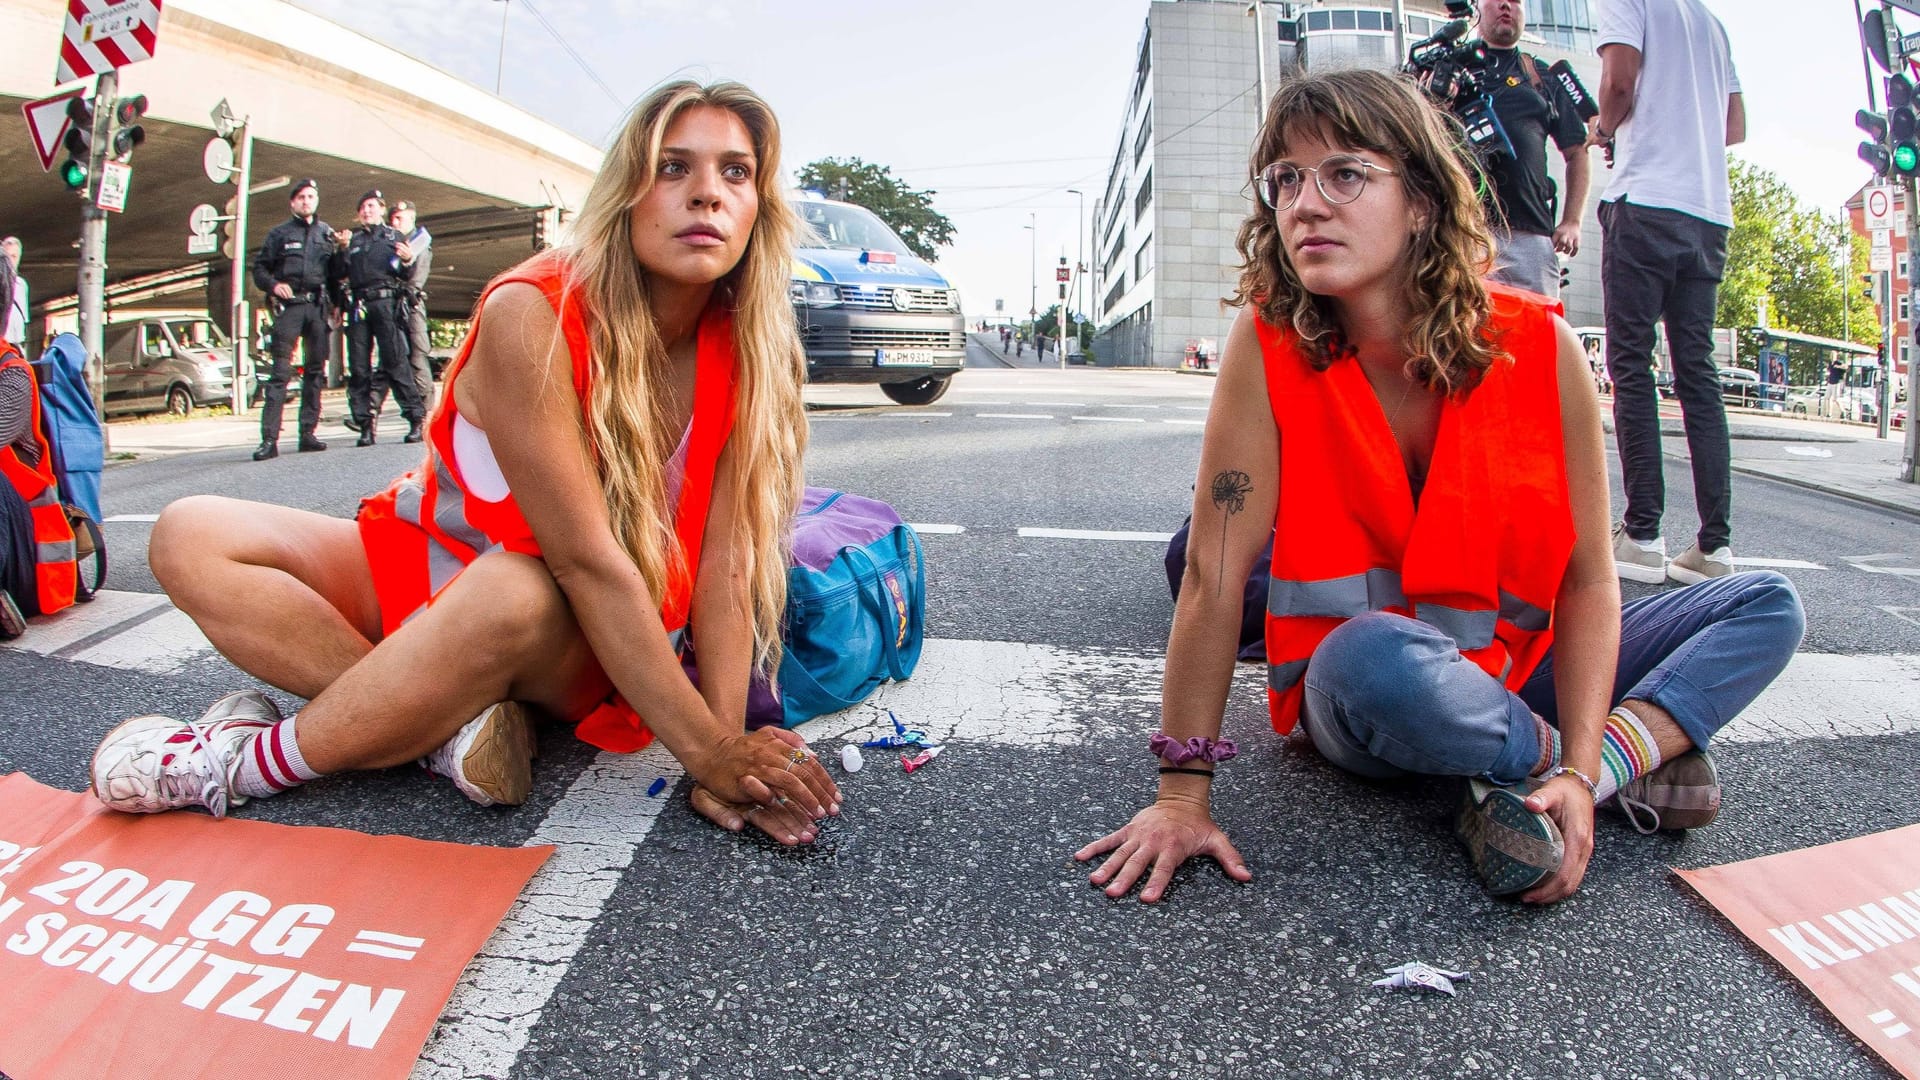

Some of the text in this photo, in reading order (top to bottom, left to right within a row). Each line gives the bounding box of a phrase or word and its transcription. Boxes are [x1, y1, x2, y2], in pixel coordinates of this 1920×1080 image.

[28, 860, 196, 931] 20A
[188, 890, 336, 959] GG
[346, 929, 426, 961] =
[5, 912, 407, 1050] SCHÜTZEN
